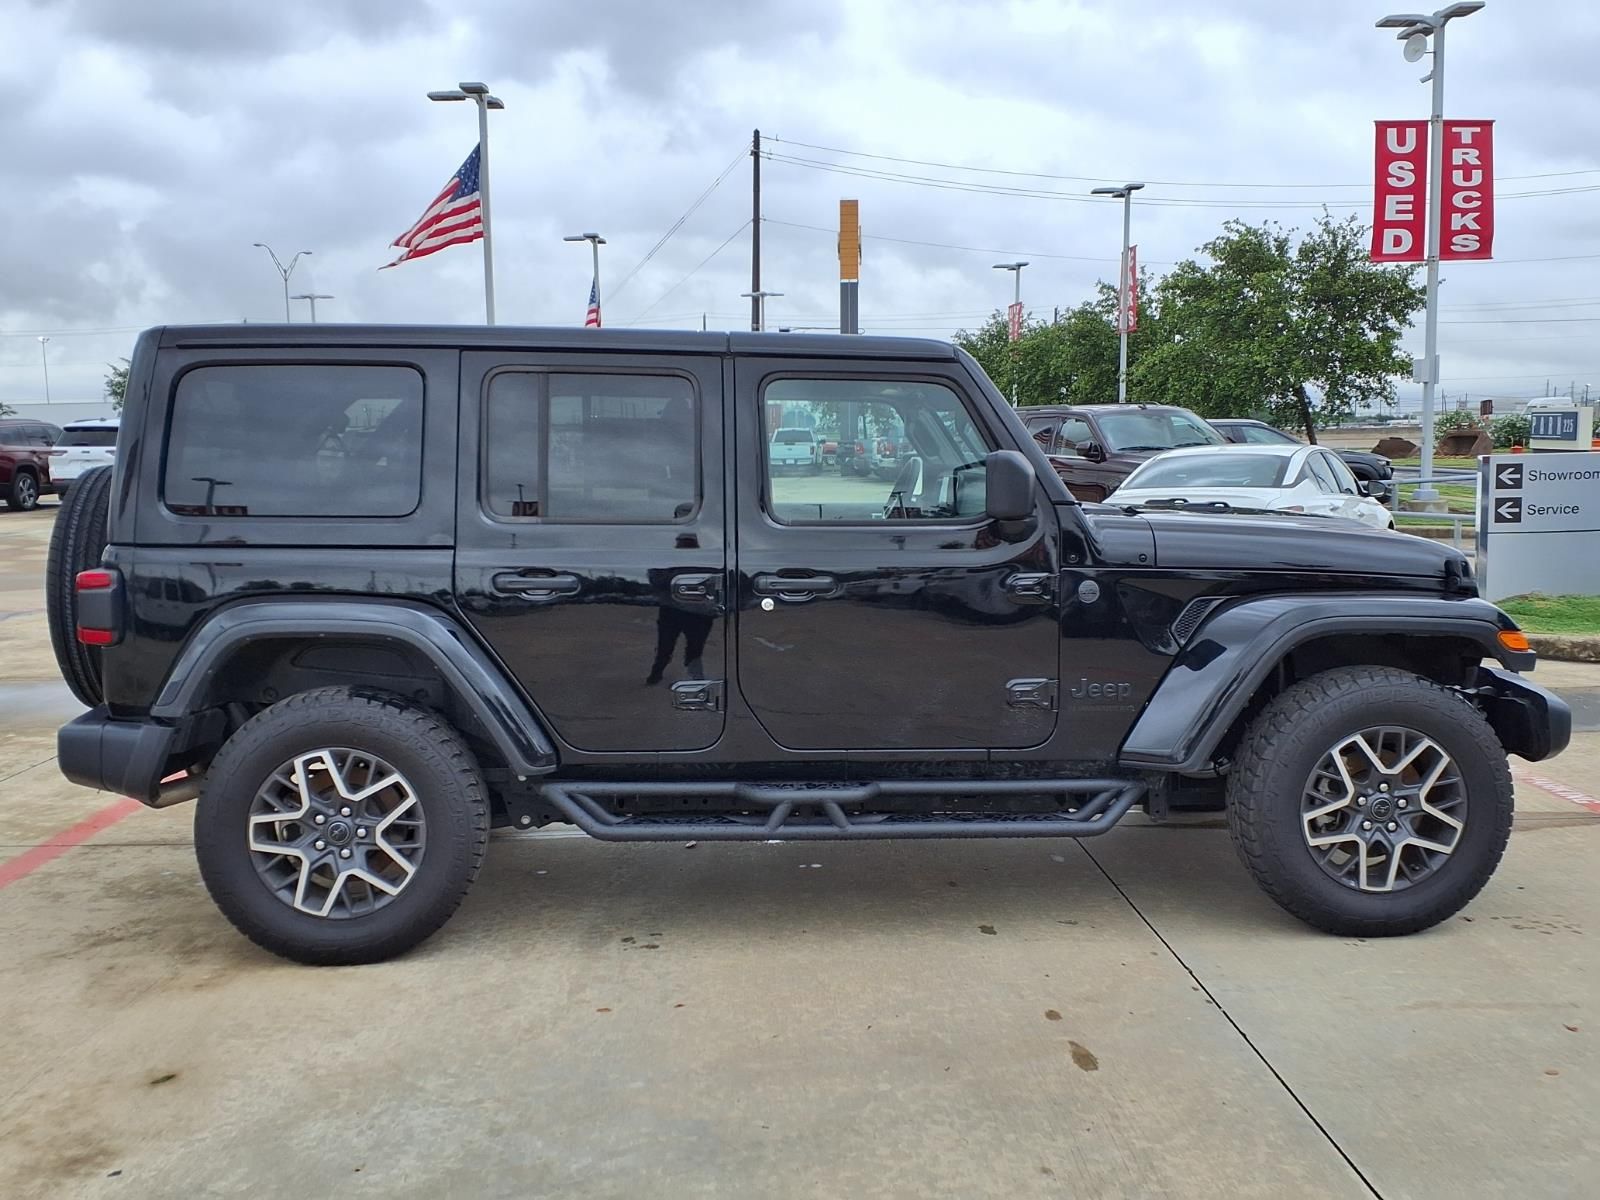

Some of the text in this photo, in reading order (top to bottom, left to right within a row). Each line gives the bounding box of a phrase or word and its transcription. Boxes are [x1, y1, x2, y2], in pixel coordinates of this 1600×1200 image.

[1382, 127, 1417, 254] USED
[1450, 126, 1483, 252] TRUCKS
[1563, 419, 1574, 433] 225
[1527, 503, 1580, 516] Service
[1071, 678, 1131, 702] Jeep
